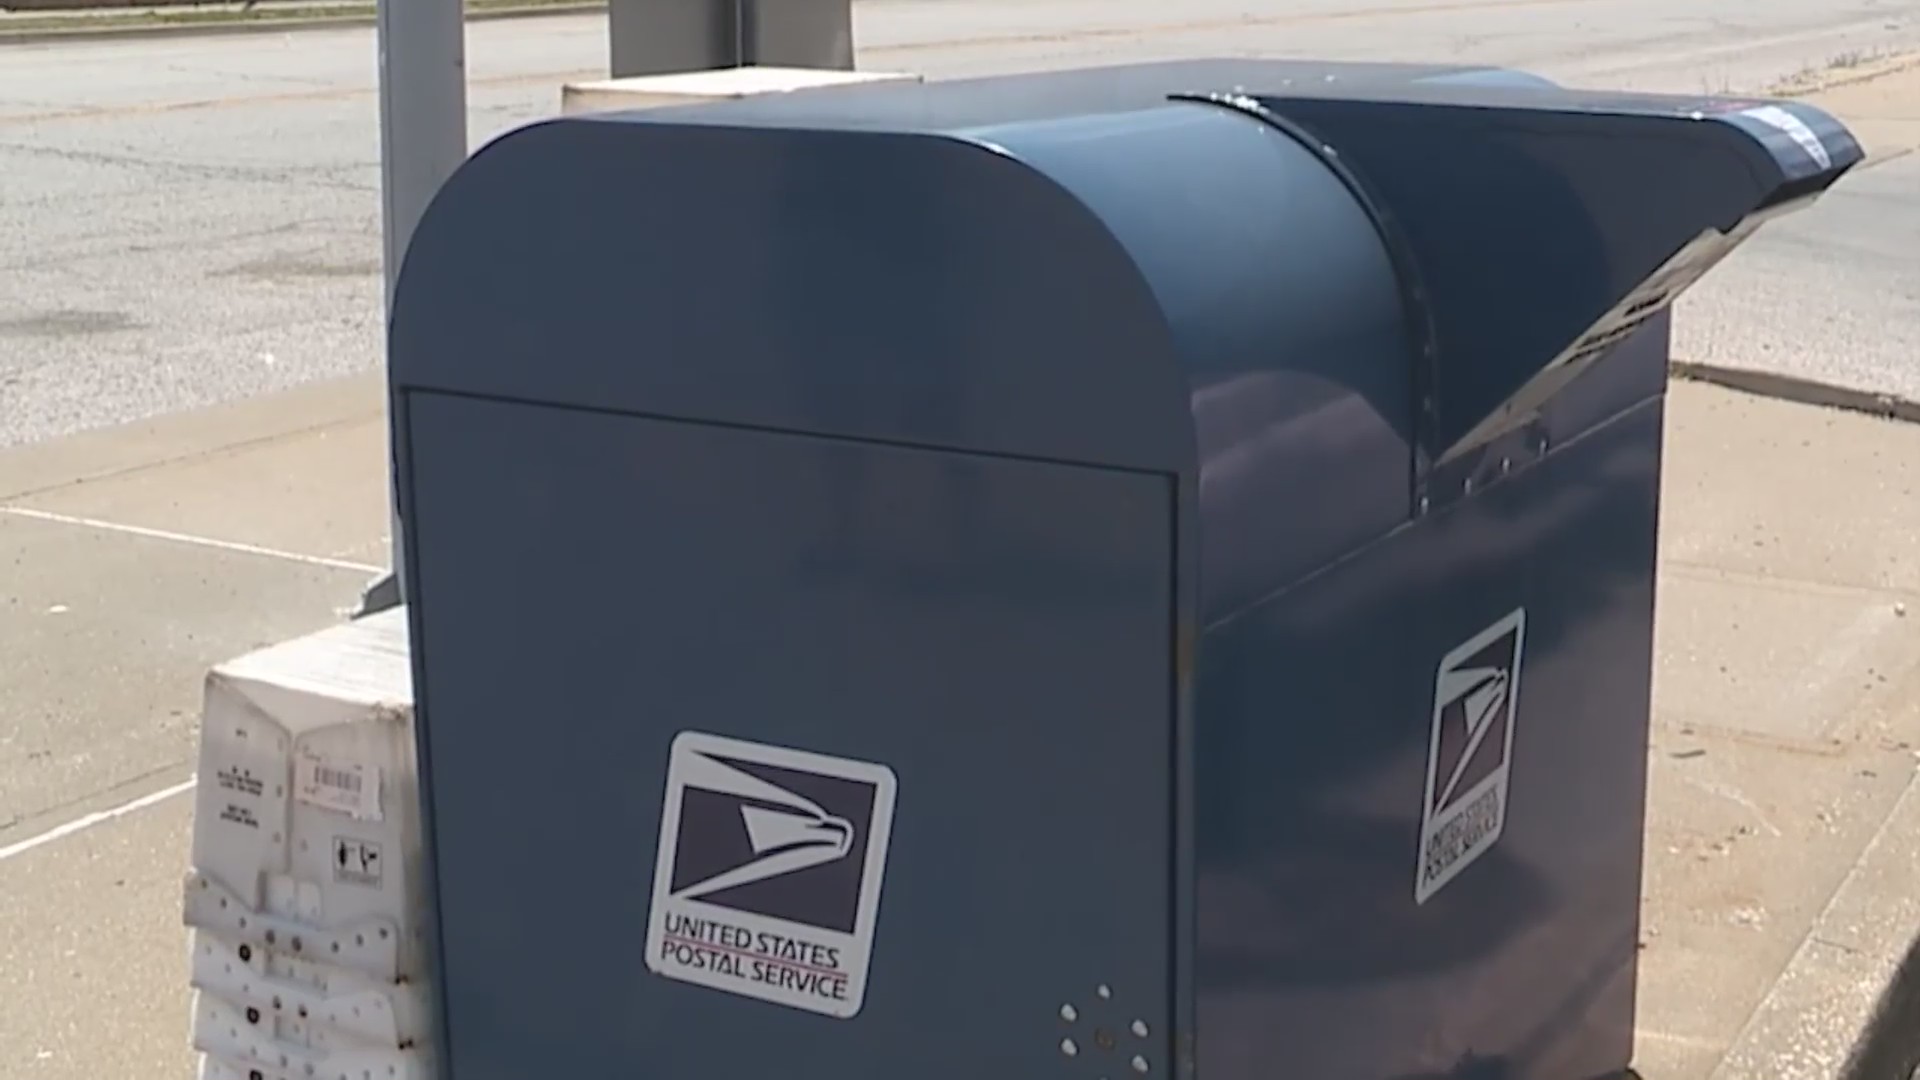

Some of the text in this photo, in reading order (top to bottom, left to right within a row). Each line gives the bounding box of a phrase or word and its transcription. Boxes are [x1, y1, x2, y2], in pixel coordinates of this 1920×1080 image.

[665, 912, 841, 969] UNITED STATES
[661, 940, 848, 1001] POSTAL SERVICE
